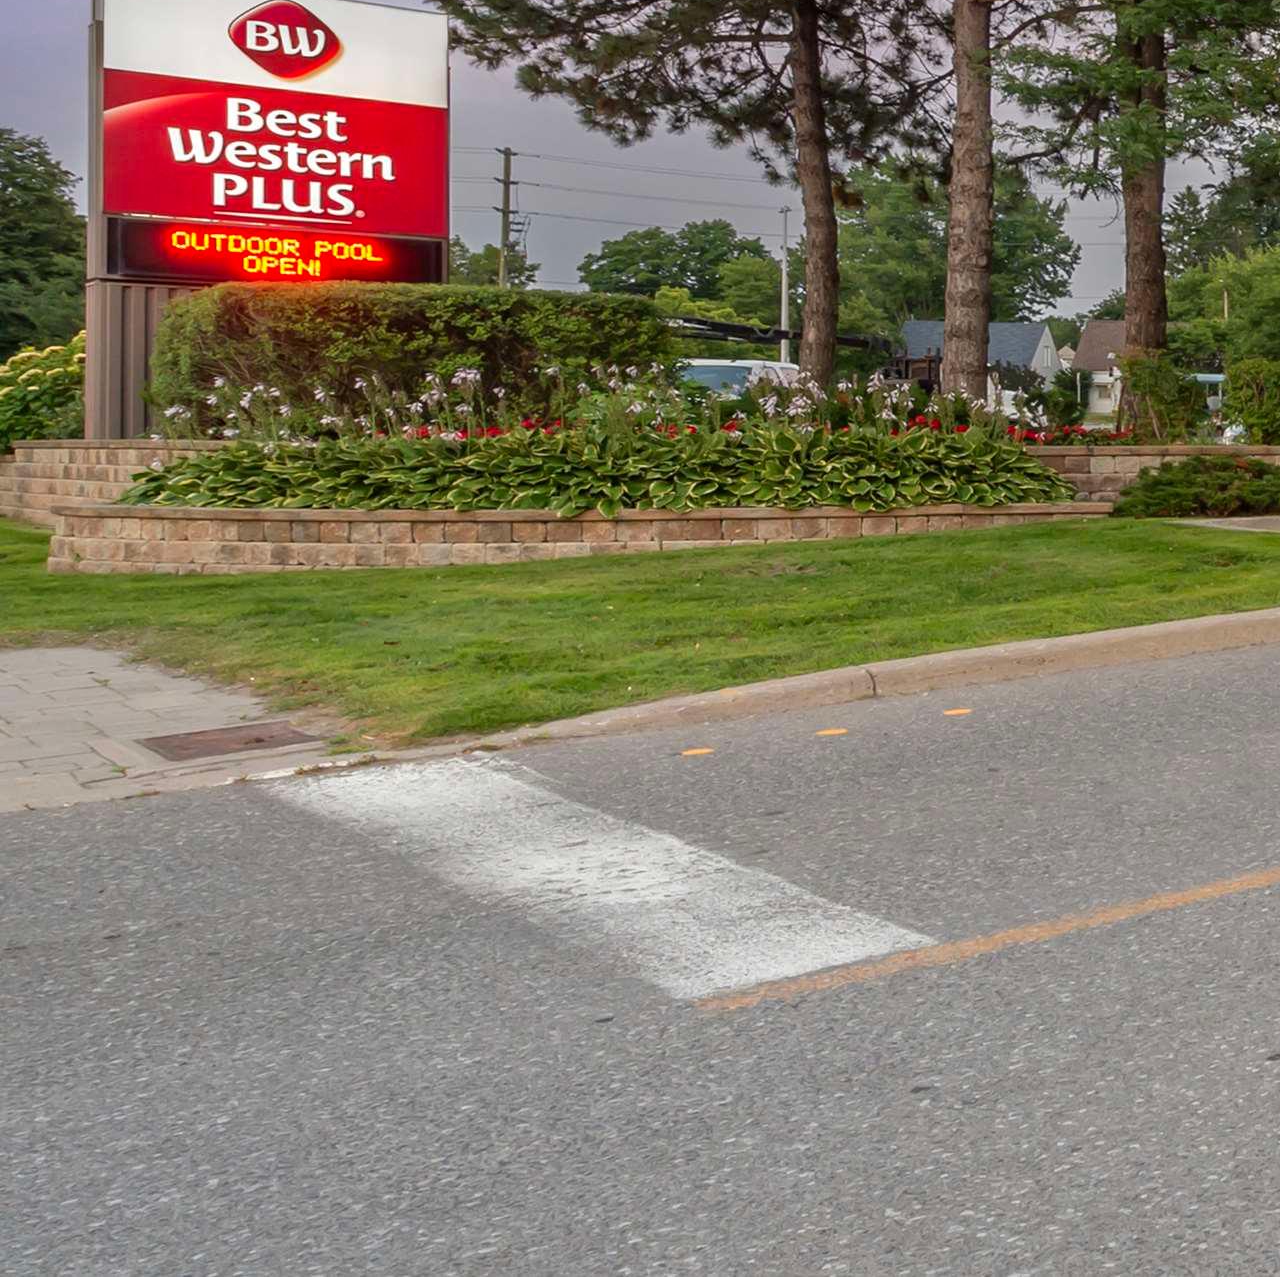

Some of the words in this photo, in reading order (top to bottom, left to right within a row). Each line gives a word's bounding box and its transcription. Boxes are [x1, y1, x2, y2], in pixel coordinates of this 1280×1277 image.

[245, 19, 326, 58] BW
[226, 96, 348, 142] Best
[167, 126, 396, 181] Western
[212, 172, 356, 217] PLUS
[171, 230, 301, 257] OUTDOOR
[314, 240, 384, 262] POOL
[242, 254, 322, 277] OPEN!
